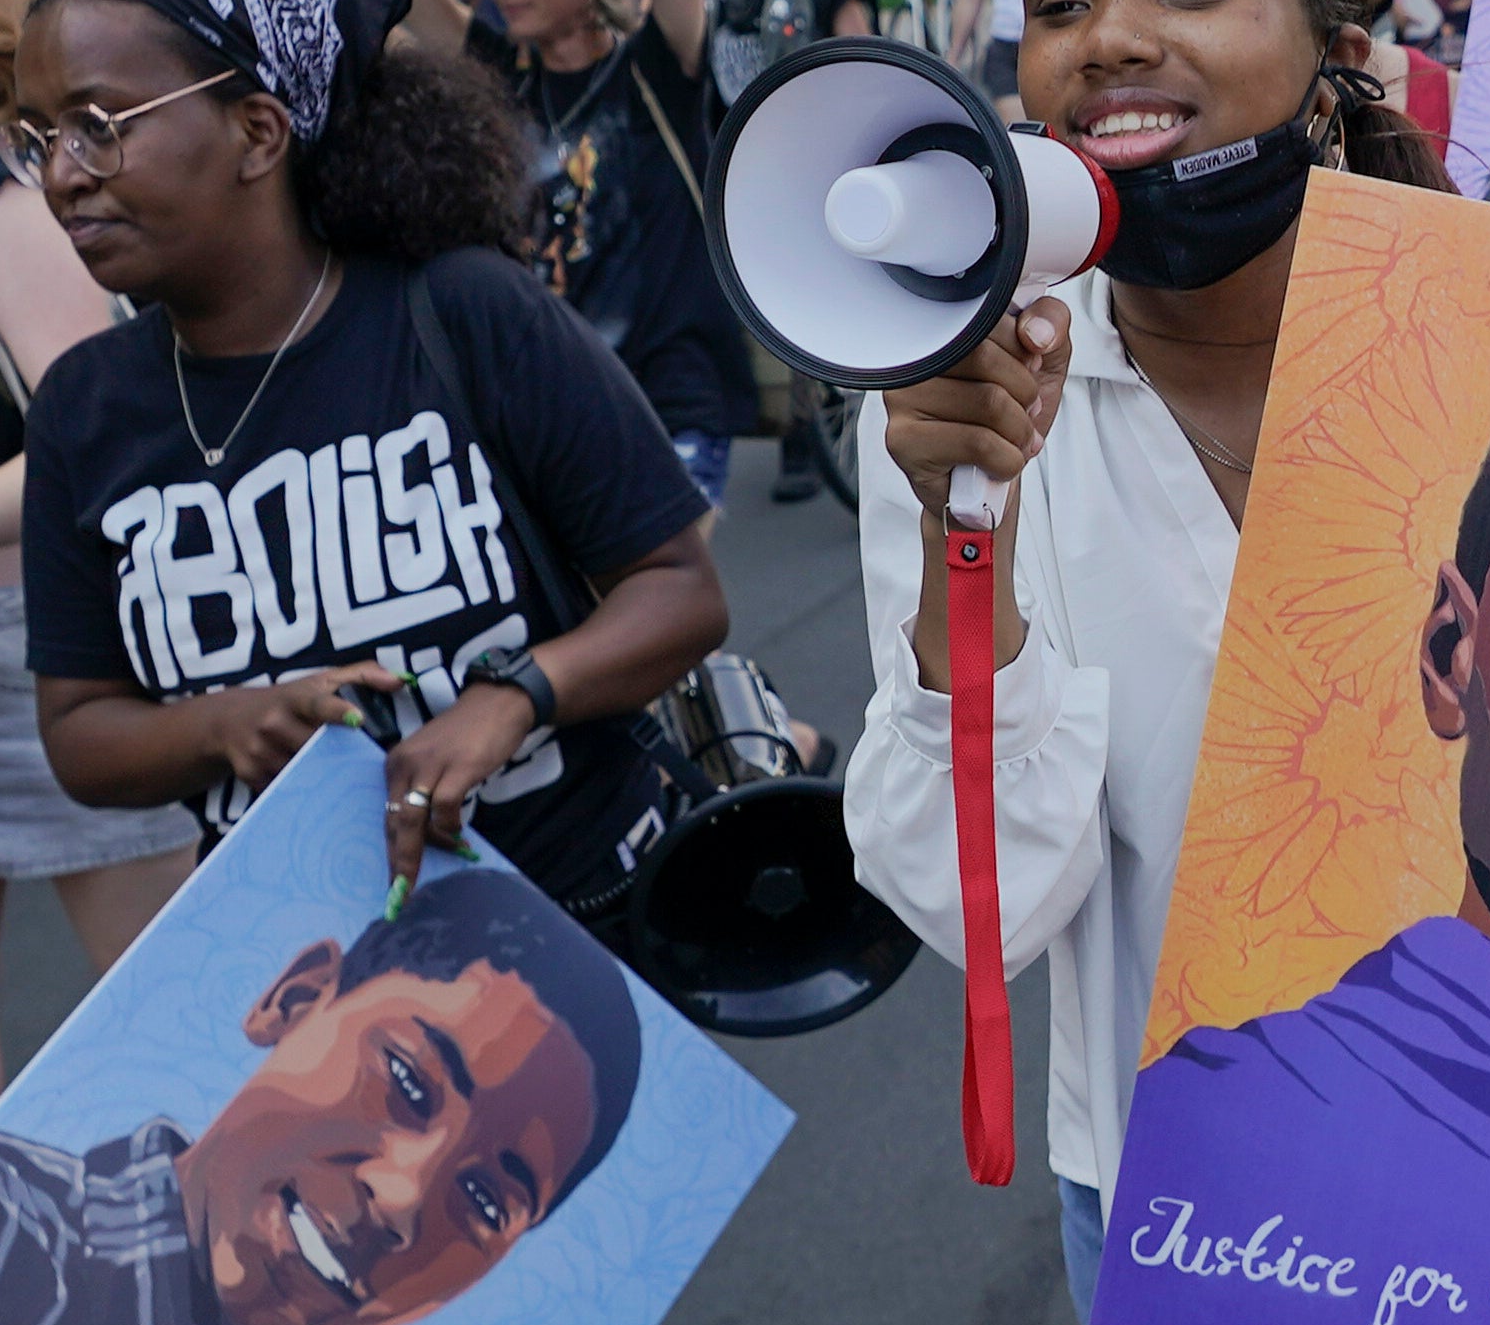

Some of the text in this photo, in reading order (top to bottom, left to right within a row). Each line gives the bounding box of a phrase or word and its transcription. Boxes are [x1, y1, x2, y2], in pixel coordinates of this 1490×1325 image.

[1181, 143, 1251, 176] STEVE MADDEN
[101, 409, 518, 690] ABOLISH
[1130, 1196, 1358, 1300] Justice
